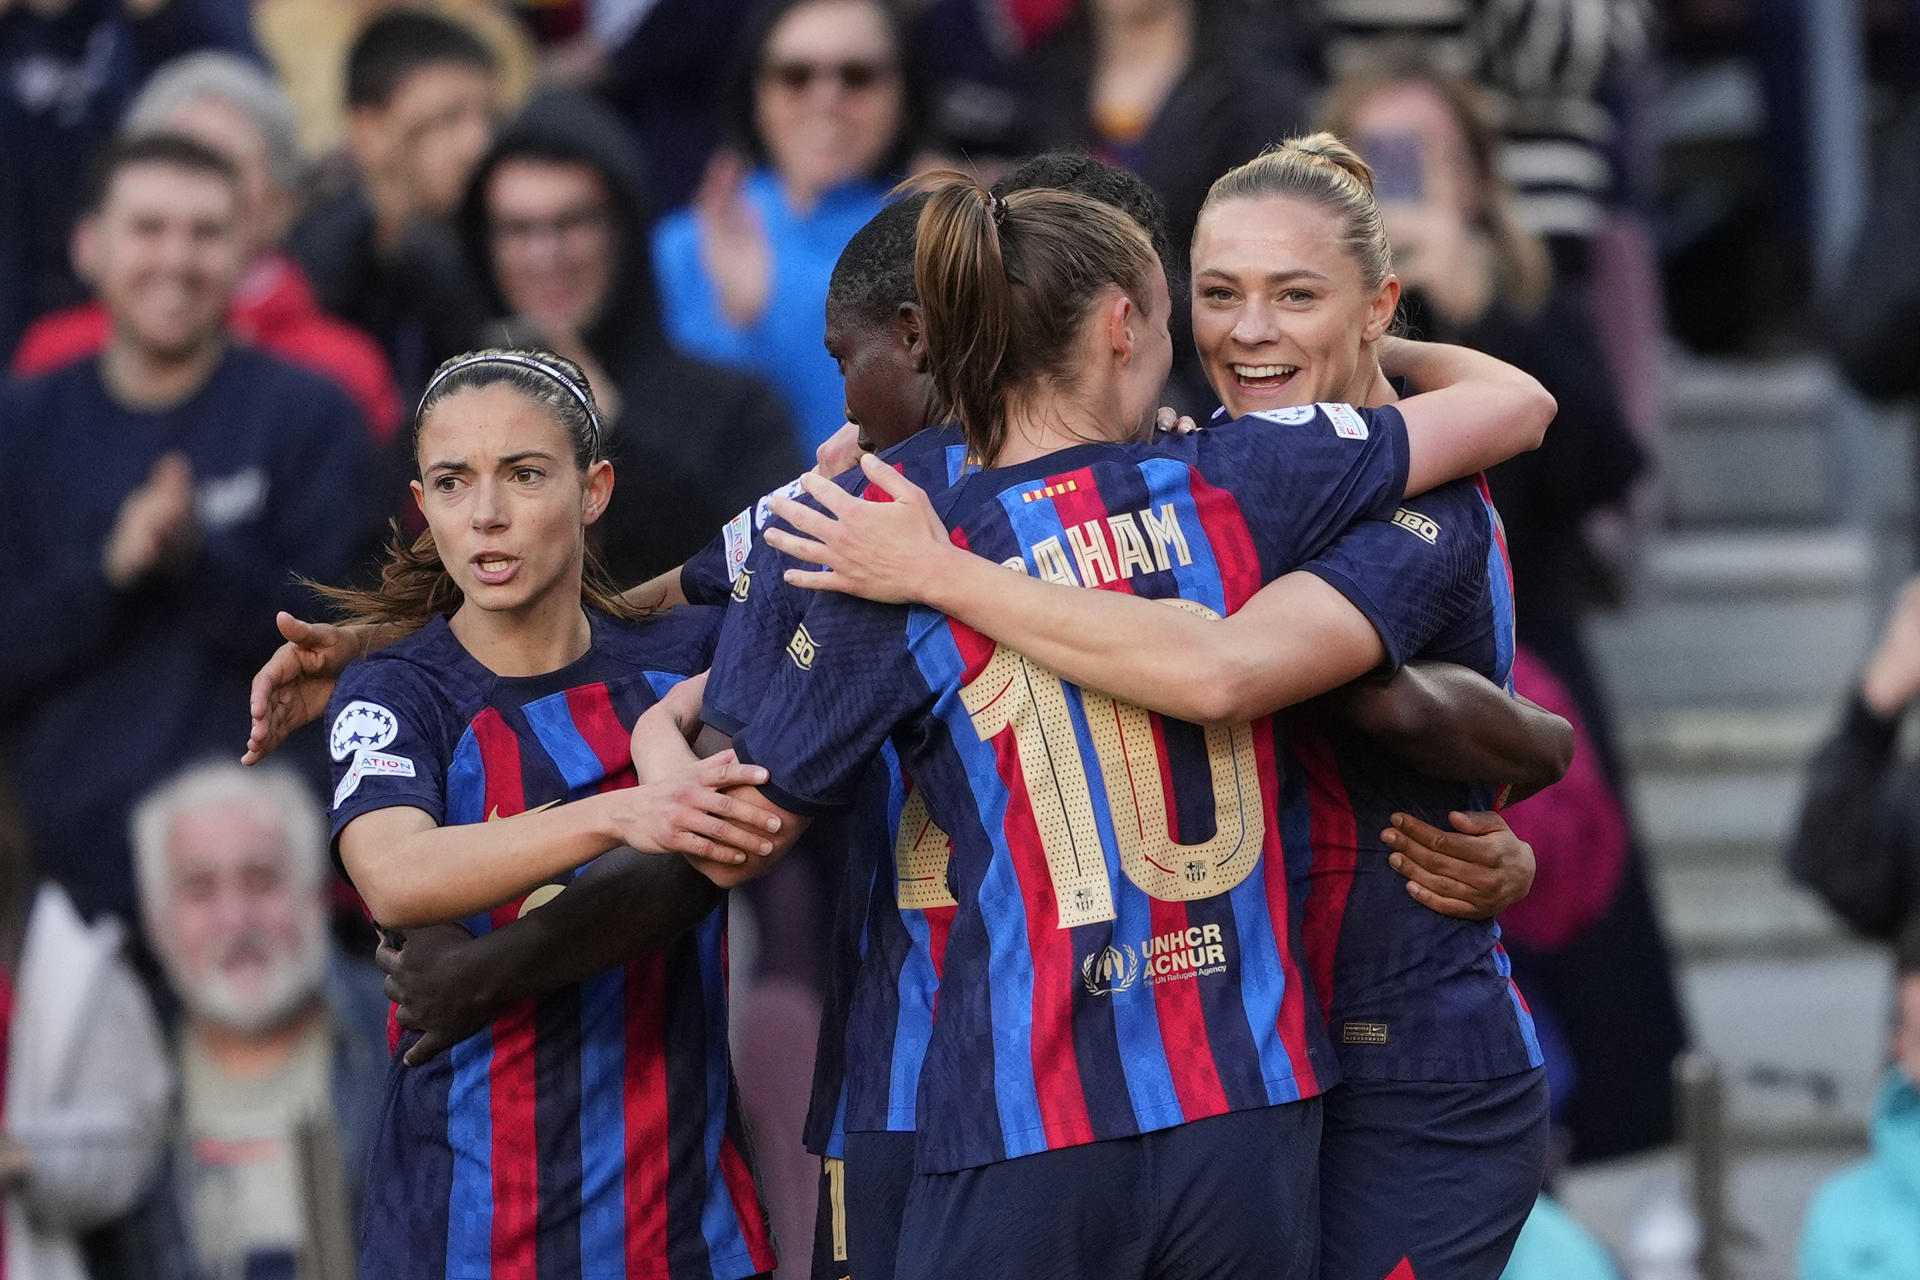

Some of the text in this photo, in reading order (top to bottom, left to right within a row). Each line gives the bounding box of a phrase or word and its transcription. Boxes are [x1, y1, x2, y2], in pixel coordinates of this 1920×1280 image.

[959, 598, 1266, 930] 10
[1141, 923, 1222, 959] UNHCR
[1143, 943, 1226, 980] ACNUR
[1155, 976, 1167, 985] UN
[1167, 971, 1198, 981] Refugee
[1198, 964, 1227, 976] Agency
